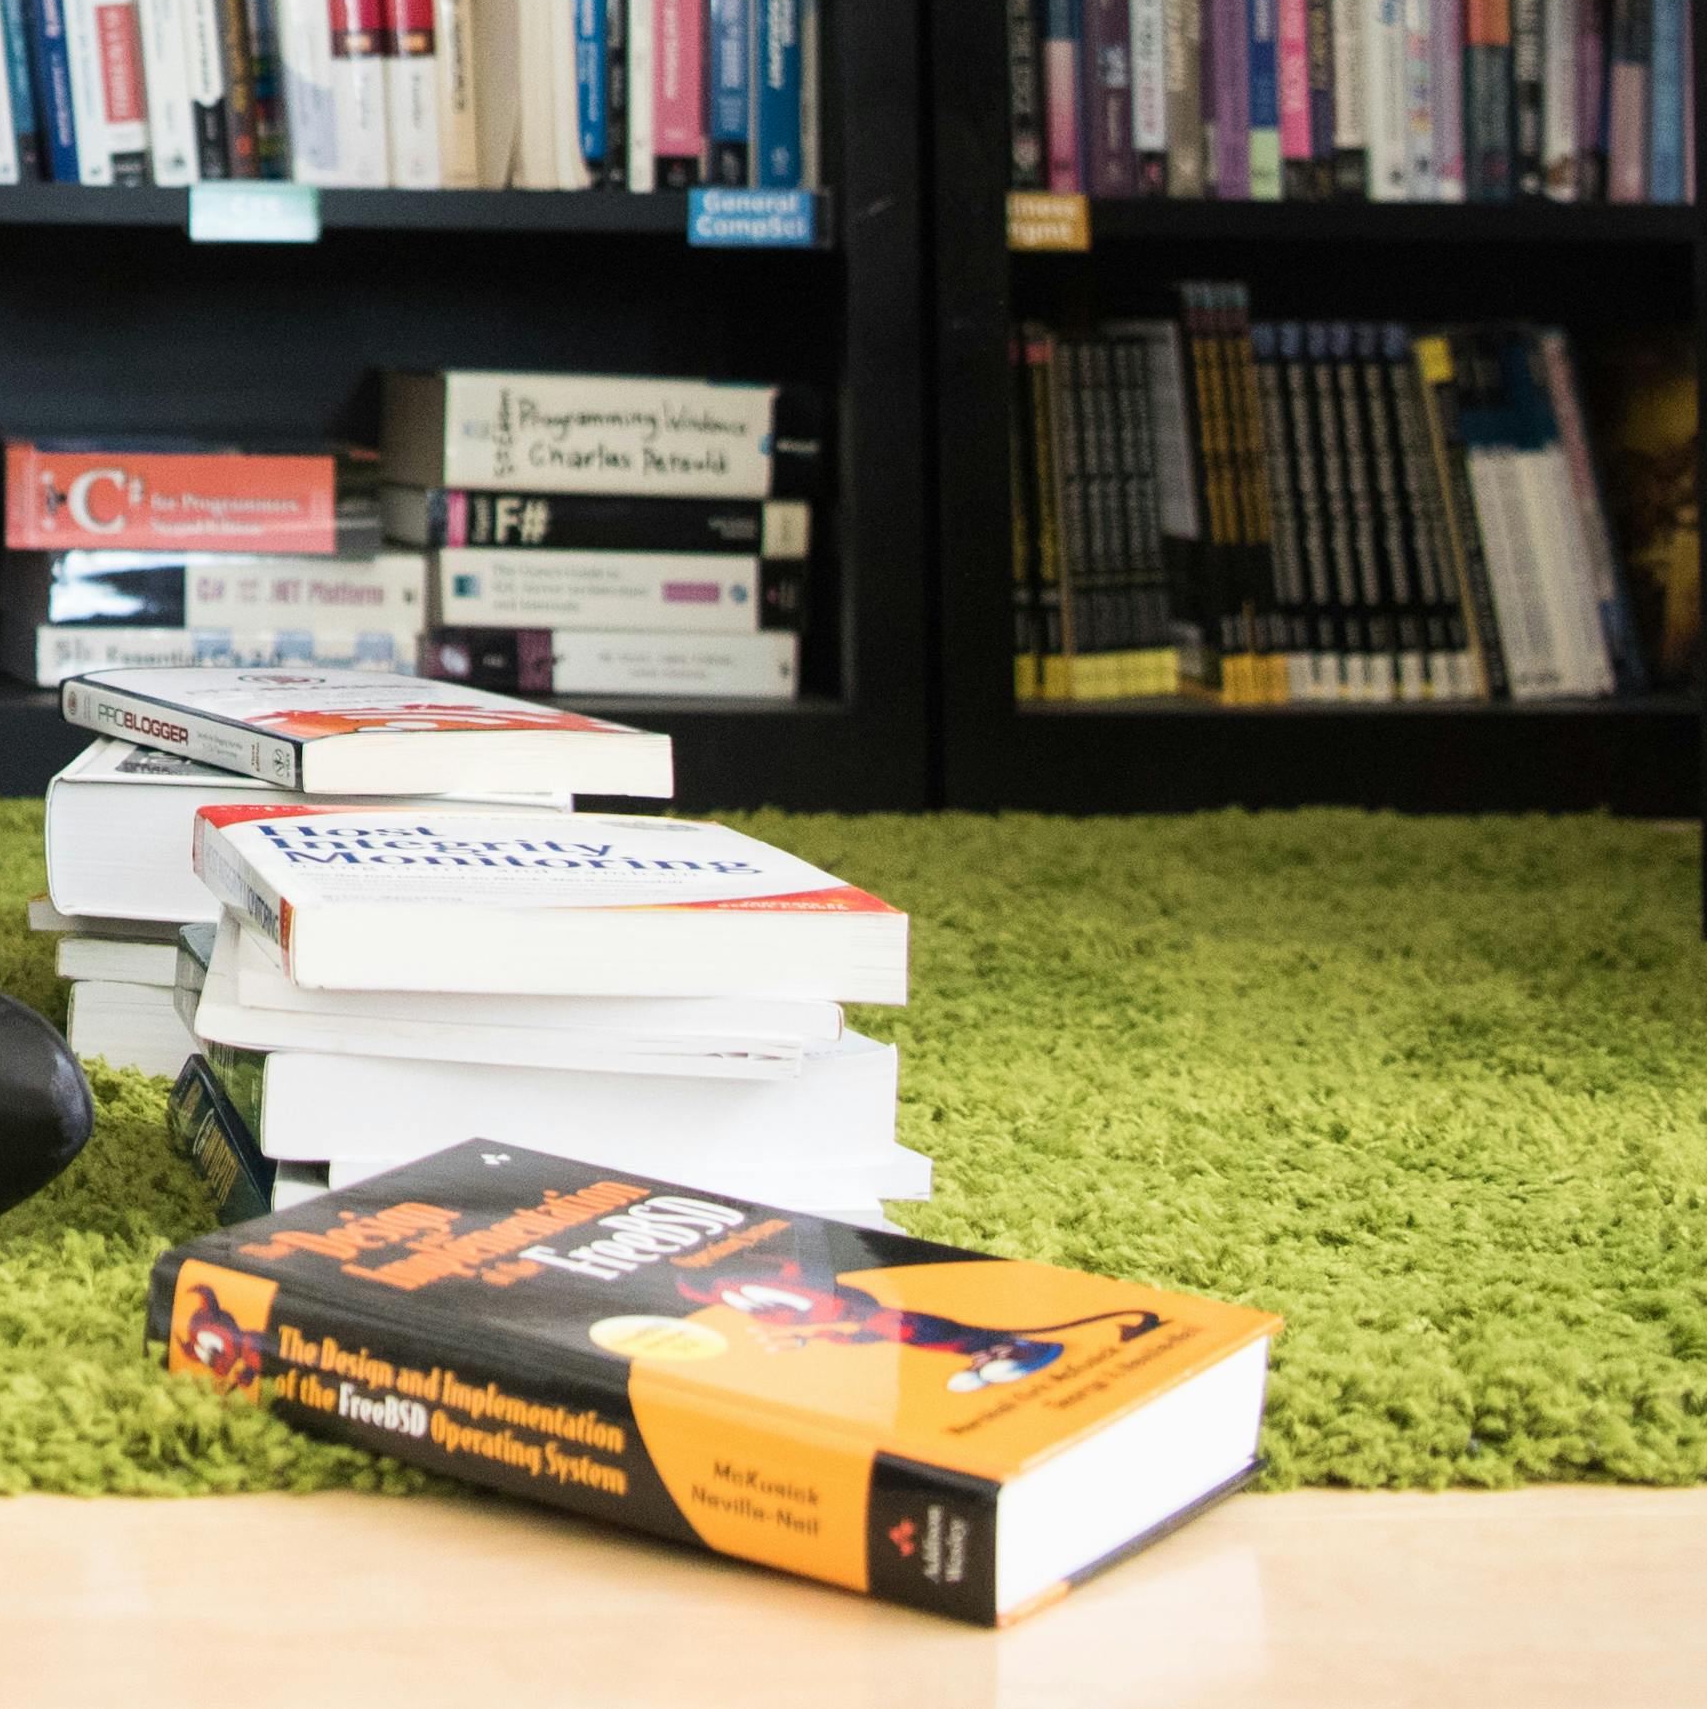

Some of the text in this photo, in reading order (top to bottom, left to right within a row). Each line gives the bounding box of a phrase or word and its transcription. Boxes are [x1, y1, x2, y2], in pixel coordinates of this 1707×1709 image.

[701, 190, 799, 215] General
[694, 213, 809, 240] CompSci
[516, 395, 658, 441] Programming
[661, 400, 748, 437] Windows
[528, 439, 633, 471] Charles
[181, 493, 300, 519] Programmers
[494, 494, 550, 545] F#
[310, 579, 385, 606] Platform
[257, 824, 444, 838] Host
[272, 837, 616, 858] Integrity
[286, 850, 764, 875] Monitoring
[339, 1180, 652, 1291] Implementation
[518, 1194, 746, 1281] FreeBSD
[278, 1324, 626, 1455] The Design and Implementation
[274, 1375, 630, 1496] of the FreeBSD Operating System
[711, 1459, 820, 1507] McKusick
[690, 1483, 821, 1538] Neville-Neil
